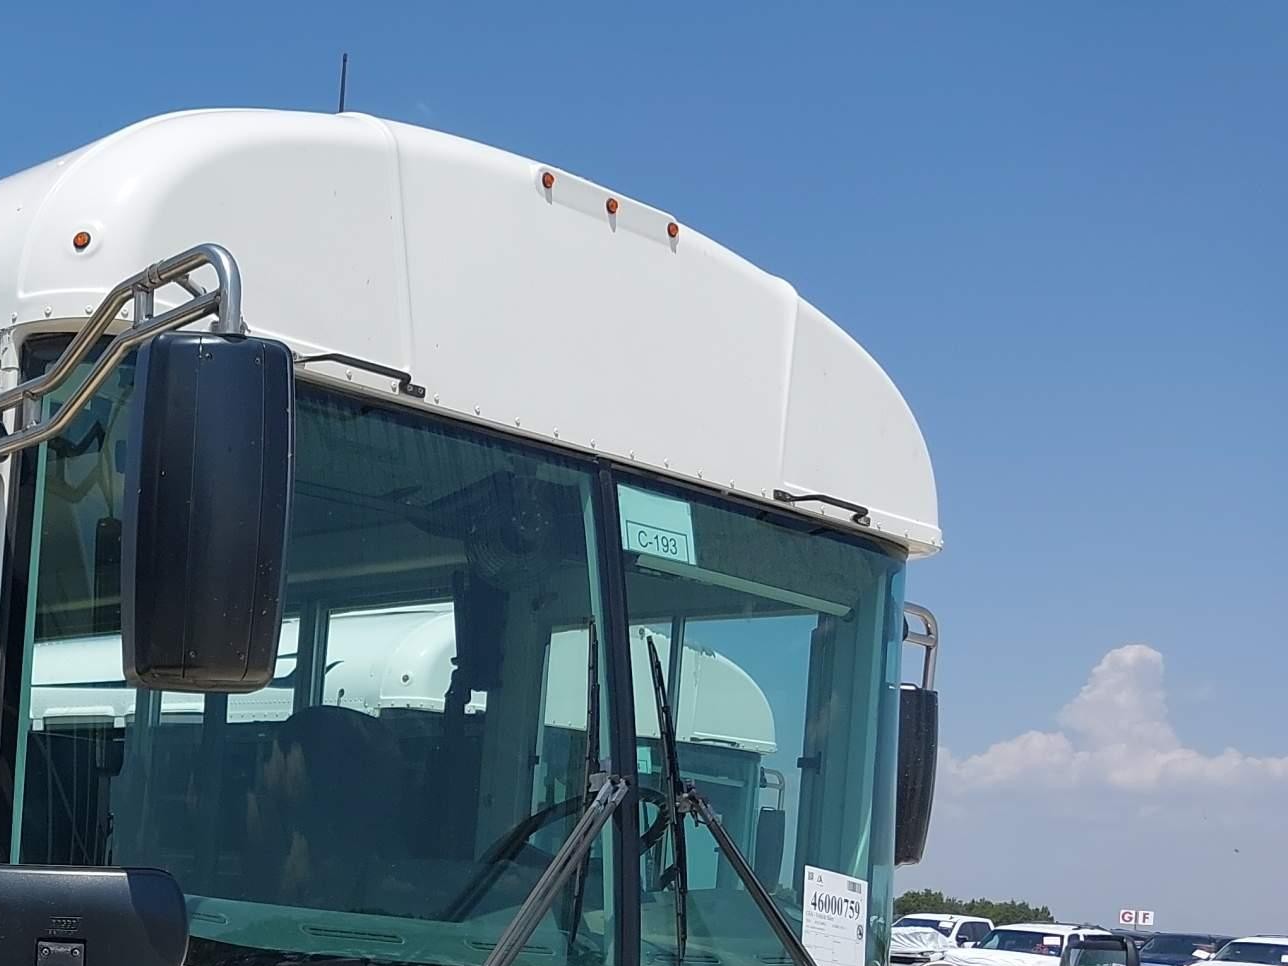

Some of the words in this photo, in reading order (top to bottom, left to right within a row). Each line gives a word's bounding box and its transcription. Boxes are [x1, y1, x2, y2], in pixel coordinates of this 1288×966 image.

[637, 530, 678, 555] C-193
[810, 891, 861, 921] 46000759
[1121, 911, 1134, 923] G
